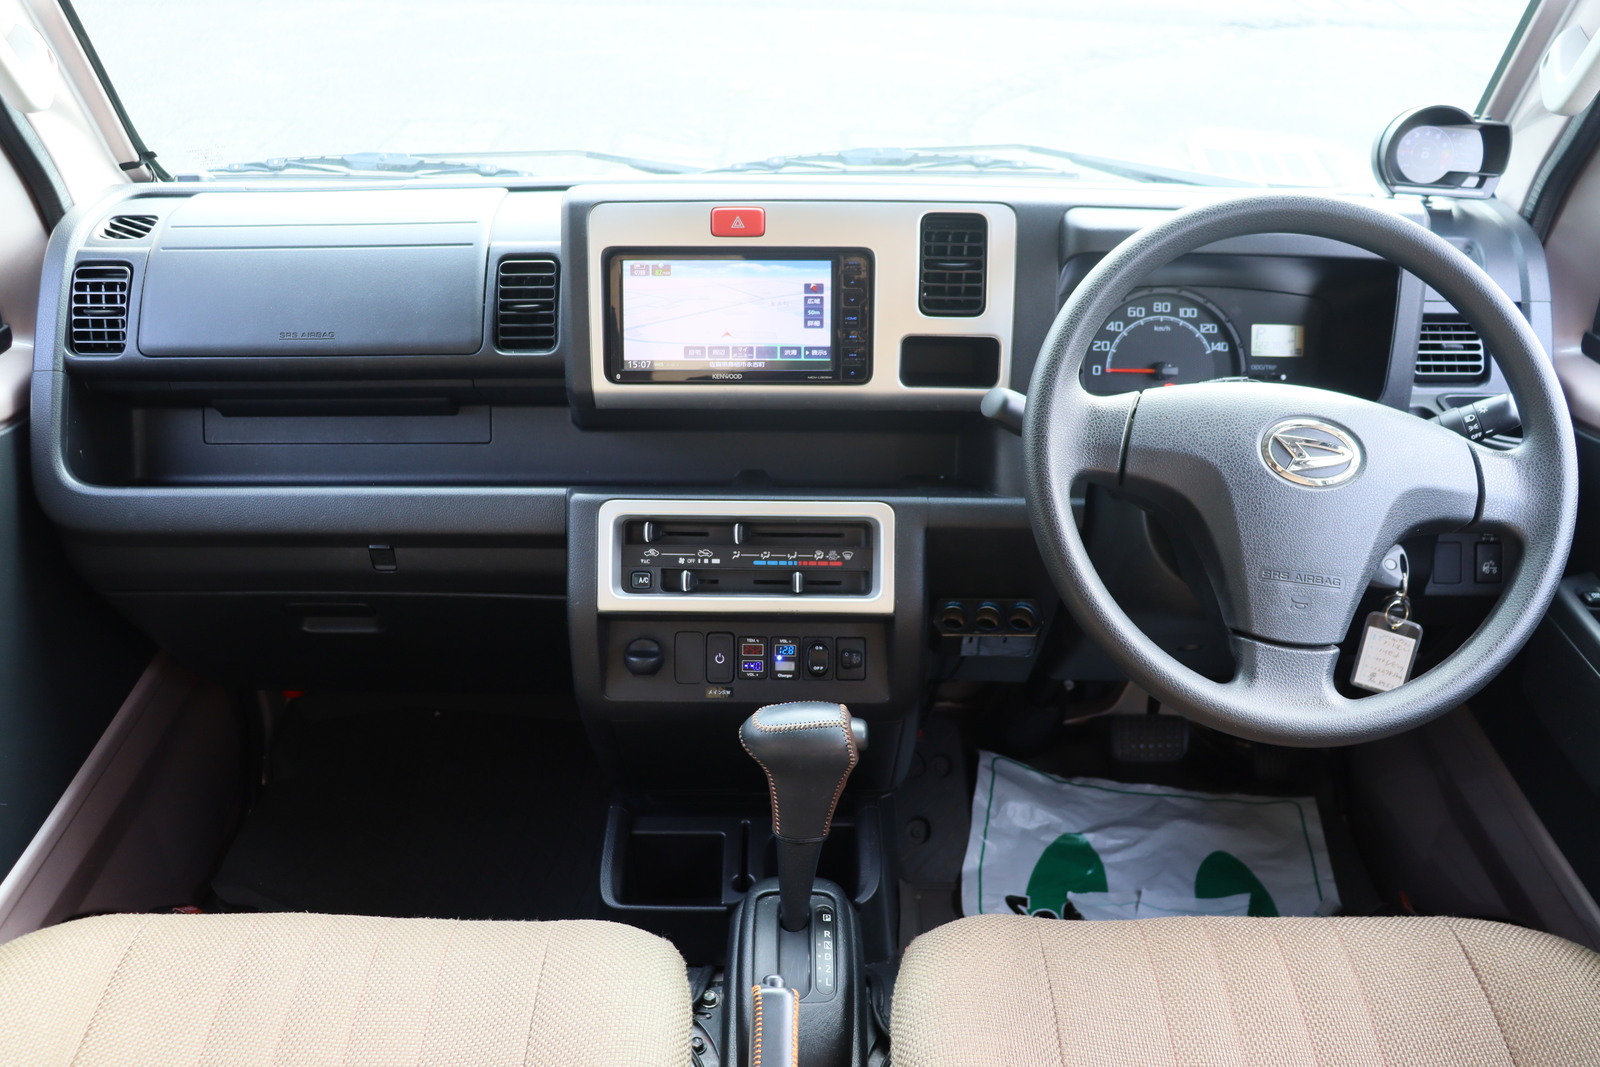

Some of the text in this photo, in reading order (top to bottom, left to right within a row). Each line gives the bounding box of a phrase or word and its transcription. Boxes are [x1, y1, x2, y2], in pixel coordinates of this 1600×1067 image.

[1128, 306, 1145, 318] 60
[1153, 302, 1170, 312] 80
[1179, 308, 1198, 318] 100
[1106, 321, 1124, 332] 40
[1200, 324, 1218, 334] 120
[1092, 340, 1110, 352] 20
[1211, 342, 1228, 352] 140
[628, 360, 652, 368] 15:07
[1092, 365, 1102, 376] 0
[1470, 432, 1482, 440] OFF
[1262, 569, 1341, 586] SRS AIRBAG
[824, 941, 831, 949] N
